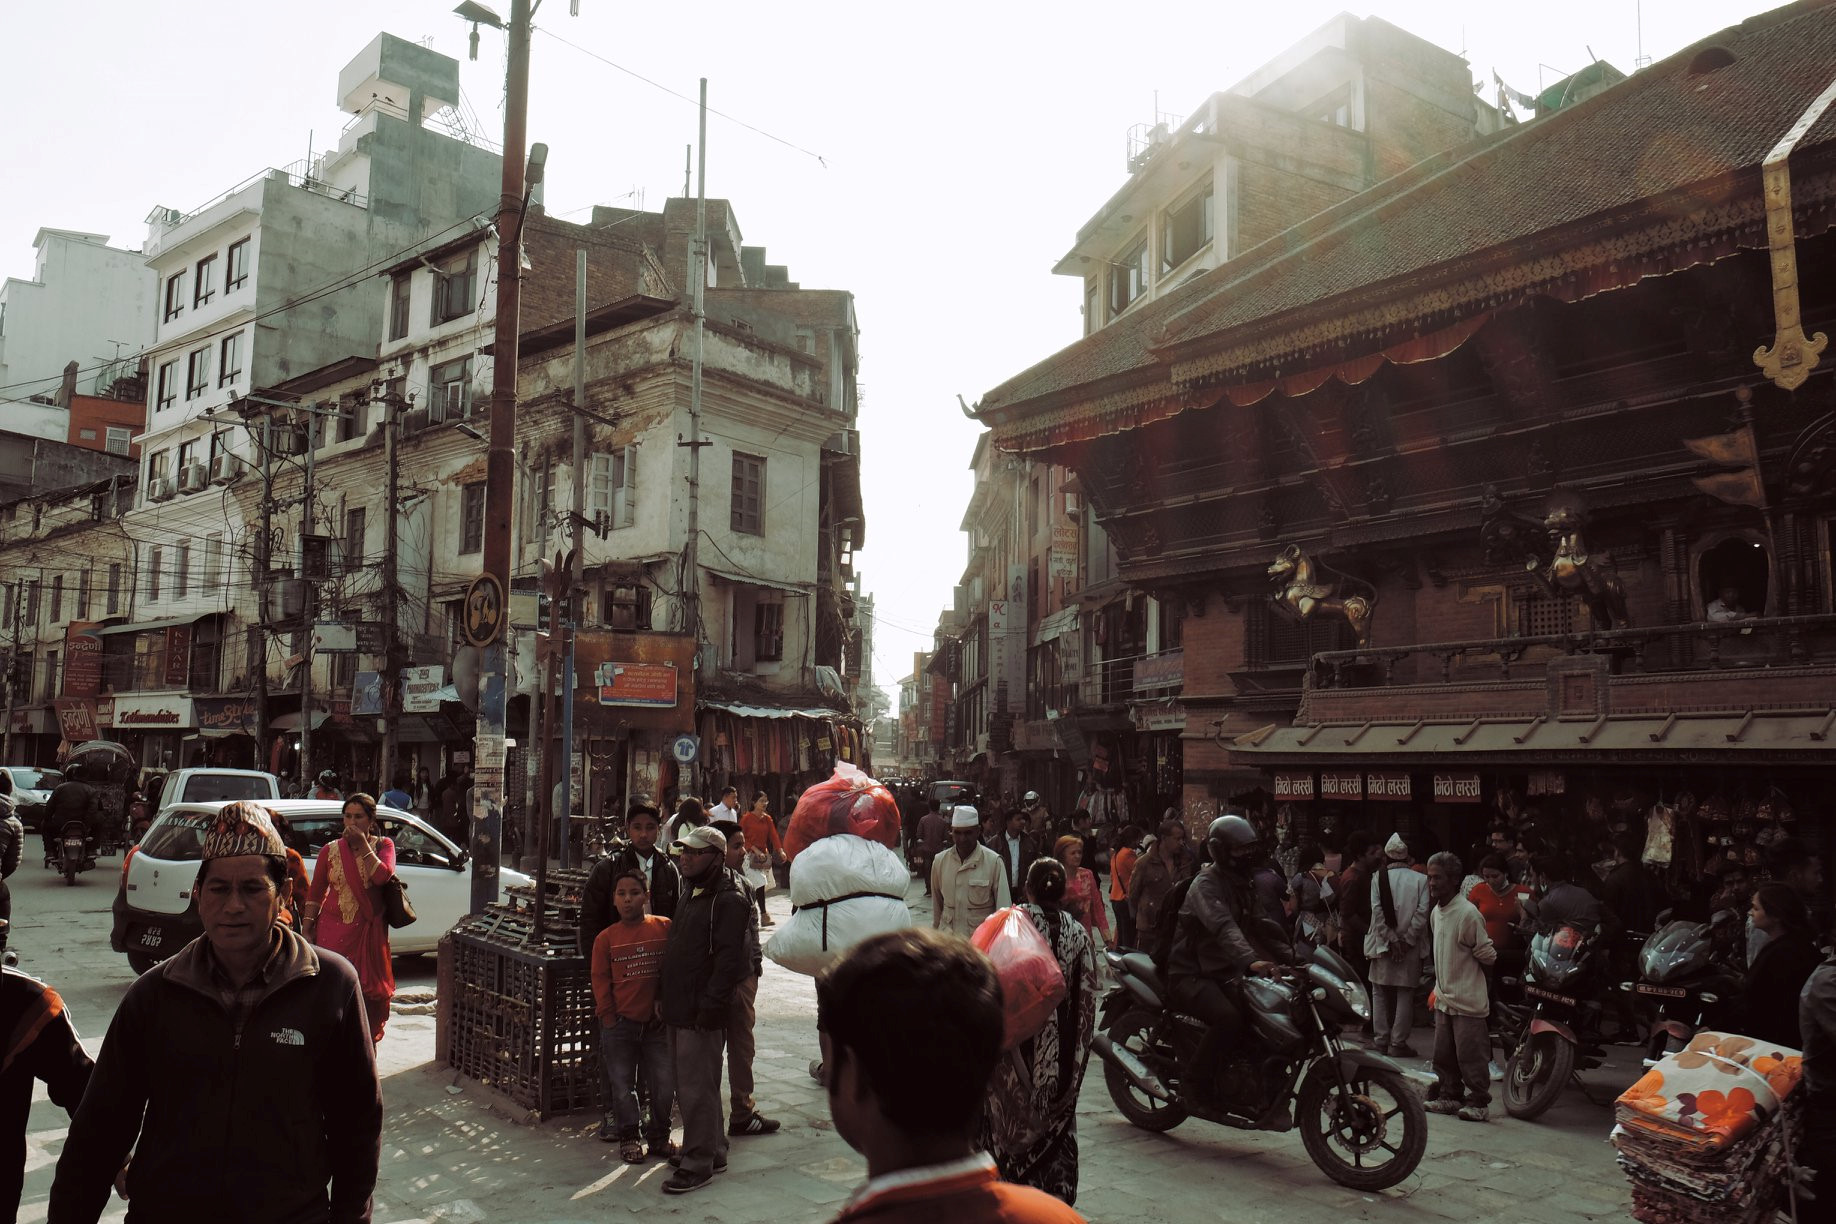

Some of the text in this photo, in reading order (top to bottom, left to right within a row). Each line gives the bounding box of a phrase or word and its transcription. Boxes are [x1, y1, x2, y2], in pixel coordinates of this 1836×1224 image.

[1275, 775, 1314, 795] मिठो लस्सी
[1321, 774, 1362, 794] मिठो लस्सी
[1367, 774, 1411, 795] मिठो लस्सी
[1434, 774, 1480, 797] मिठो लस्सी
[276, 1037, 293, 1045] FACE
